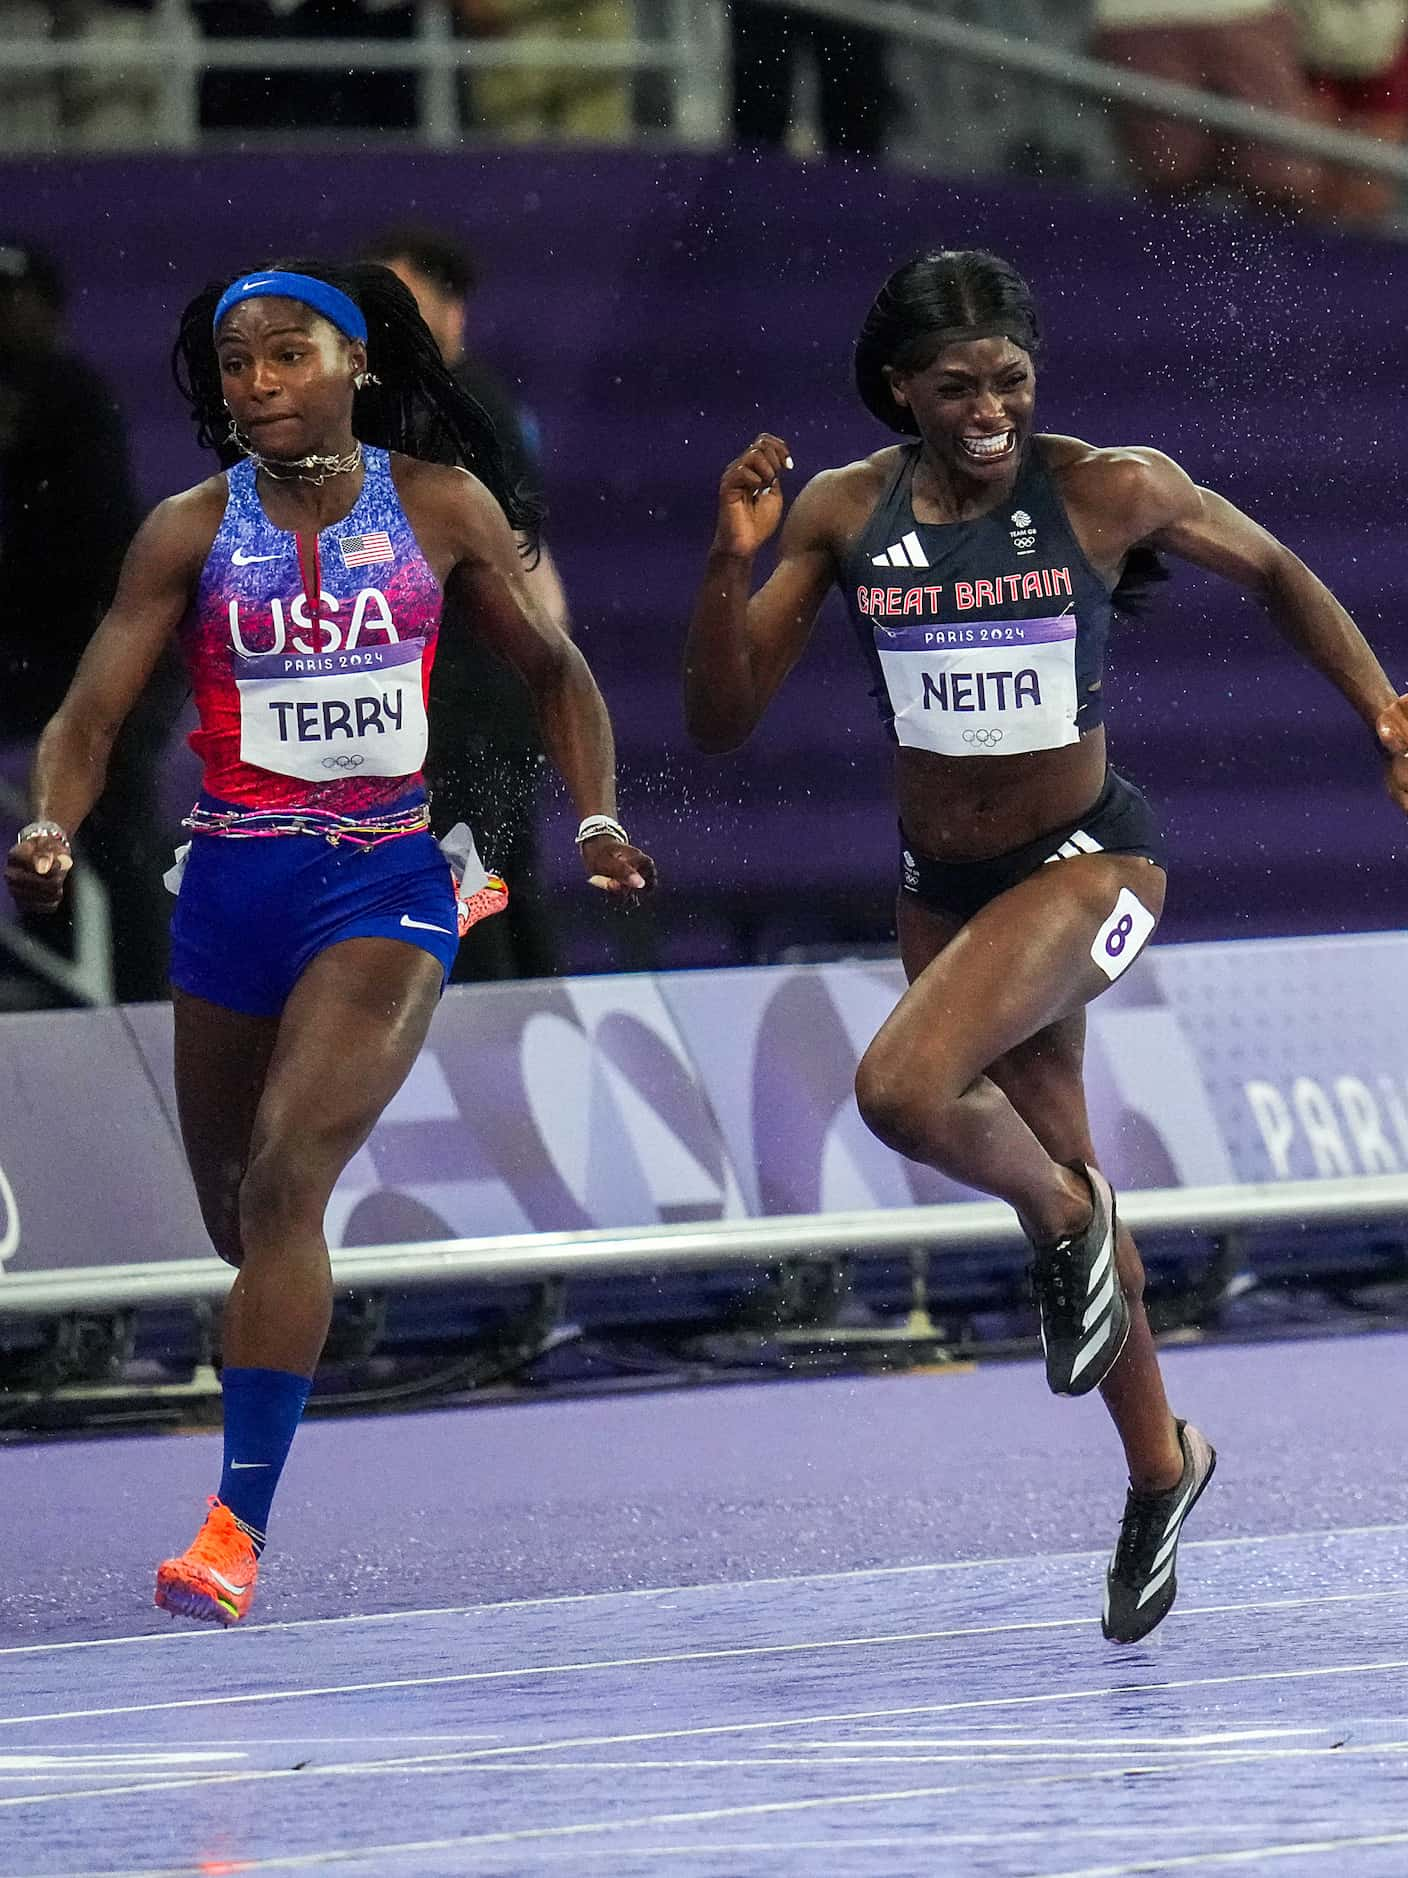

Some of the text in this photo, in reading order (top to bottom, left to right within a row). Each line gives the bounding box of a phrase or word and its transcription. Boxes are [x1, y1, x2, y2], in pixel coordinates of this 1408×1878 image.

[1009, 529, 1027, 538] TEAM
[857, 567, 1073, 616] GREAT BRITAIN
[229, 587, 400, 657] USA
[925, 628, 1025, 644] PARIS 2024
[284, 652, 384, 672] PARIS 2024
[921, 669, 1042, 712] NEITA
[268, 688, 402, 742] TERRY
[1105, 913, 1133, 958] 8
